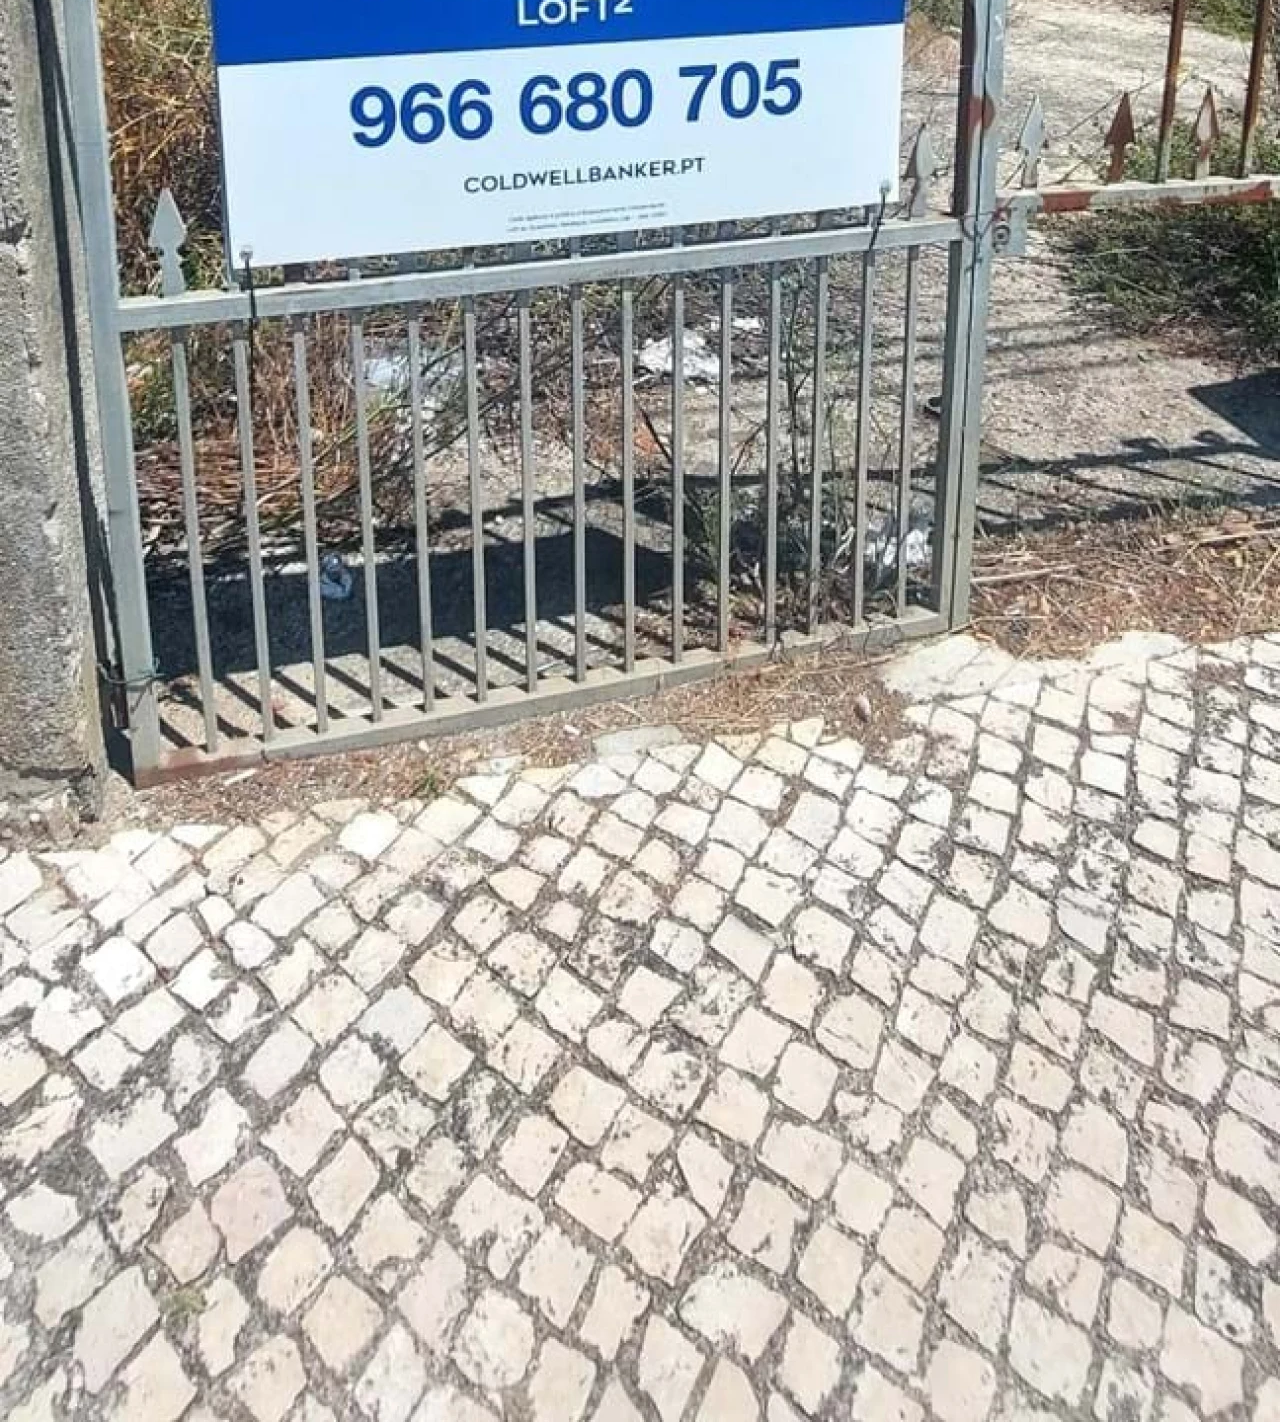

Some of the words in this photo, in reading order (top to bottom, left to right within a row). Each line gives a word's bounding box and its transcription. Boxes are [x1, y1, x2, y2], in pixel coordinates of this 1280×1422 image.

[350, 79, 493, 148] 966
[519, 69, 653, 135] 680
[679, 59, 803, 122] 705
[463, 157, 706, 194] COLDWELLBANKER.PT
